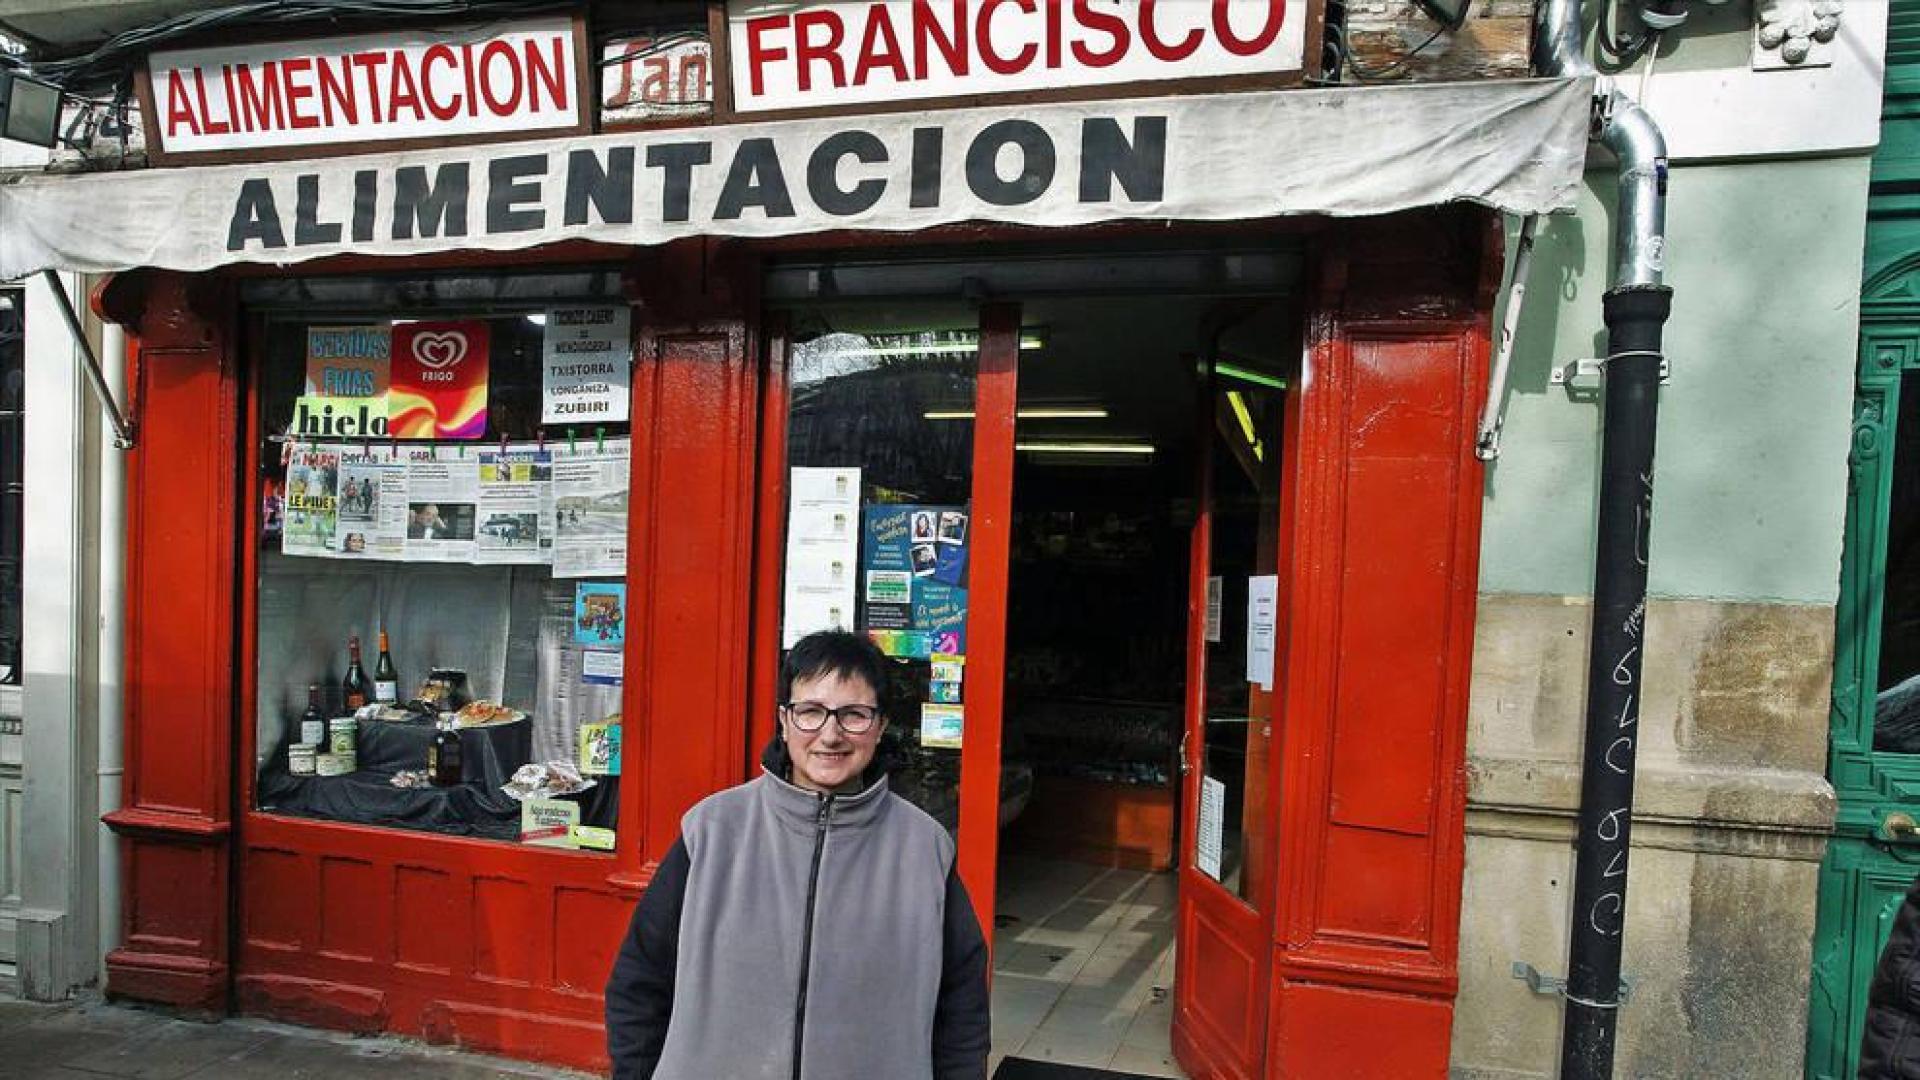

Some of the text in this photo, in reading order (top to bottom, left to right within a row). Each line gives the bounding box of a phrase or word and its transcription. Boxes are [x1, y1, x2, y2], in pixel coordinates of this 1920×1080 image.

[746, 0, 1286, 96] FRANCISCO
[167, 36, 568, 138] ALIMENTACION
[606, 38, 707, 107] San
[227, 116, 1168, 251] ALIMENTACION
[422, 371, 455, 381] FRIGO
[550, 362, 616, 378] TXISTORRA
[550, 383, 610, 397] LONGANIZA
[298, 404, 389, 435] hielo
[554, 400, 610, 414] ZUBIRI
